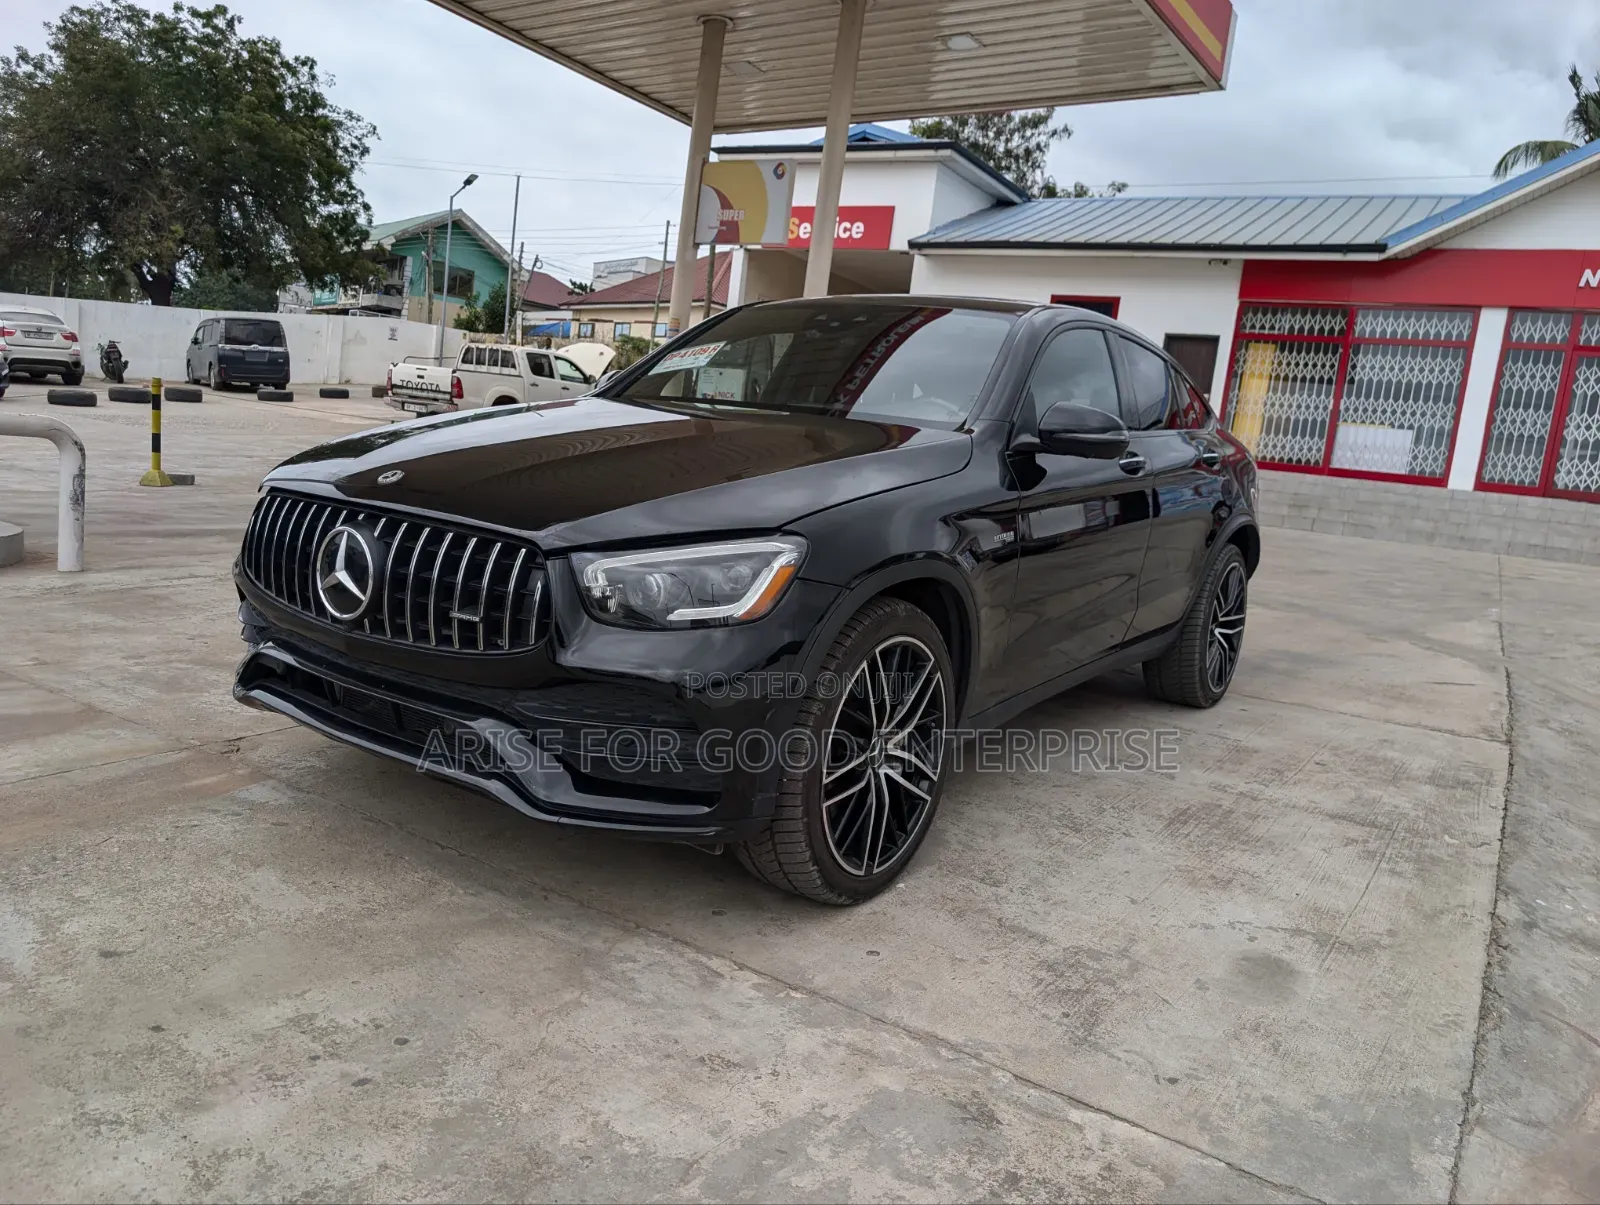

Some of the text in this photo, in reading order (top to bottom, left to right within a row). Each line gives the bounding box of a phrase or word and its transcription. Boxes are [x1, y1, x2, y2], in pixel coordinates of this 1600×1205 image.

[717, 209, 745, 221] SUPER
[788, 216, 865, 239] Seice
[399, 379, 441, 394] TOYOTA
